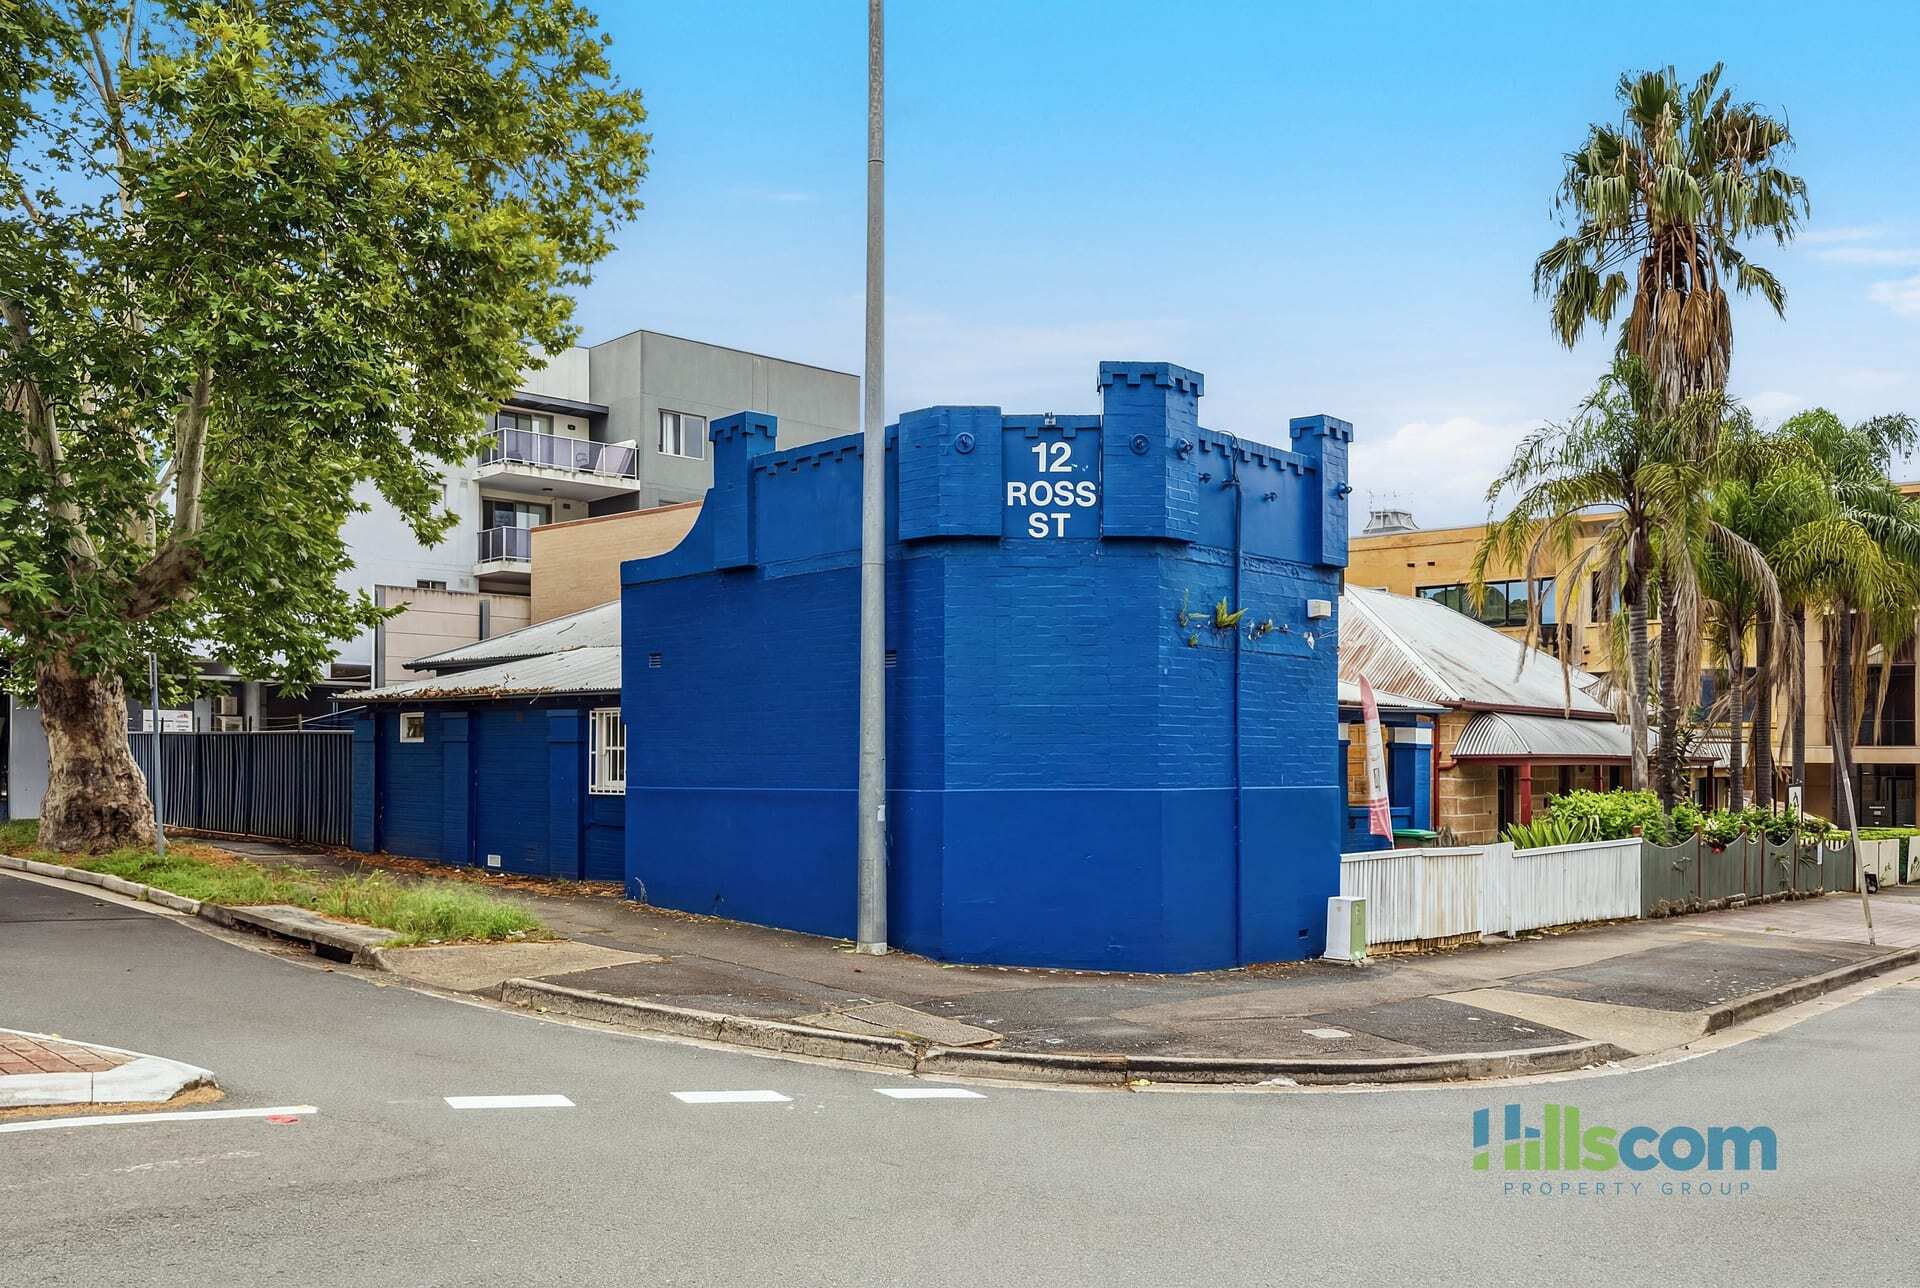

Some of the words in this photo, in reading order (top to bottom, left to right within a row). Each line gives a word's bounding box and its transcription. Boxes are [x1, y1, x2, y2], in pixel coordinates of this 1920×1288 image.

[1031, 442, 1072, 473] 12
[1007, 481, 1097, 507] ROSS
[1028, 512, 1071, 538] ST
